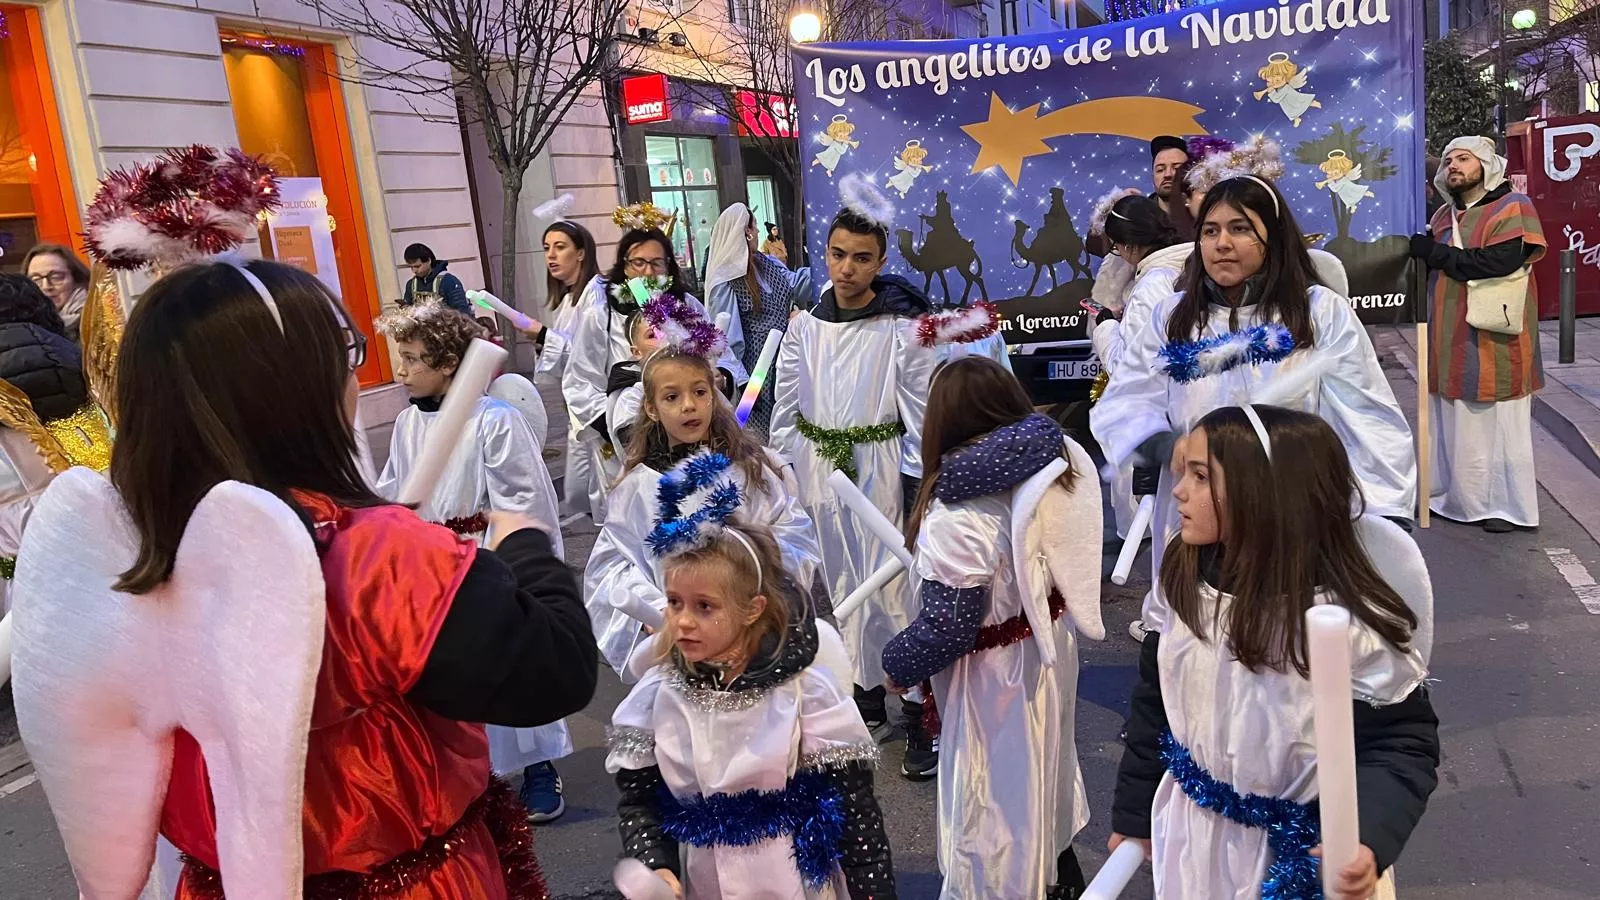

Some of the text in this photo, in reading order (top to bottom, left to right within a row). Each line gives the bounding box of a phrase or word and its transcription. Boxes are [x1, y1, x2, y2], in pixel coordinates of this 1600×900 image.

[805, 0, 1391, 107] Los angelitos de la Navidad
[628, 101, 663, 116] suma
[1056, 363, 1075, 378] HU
